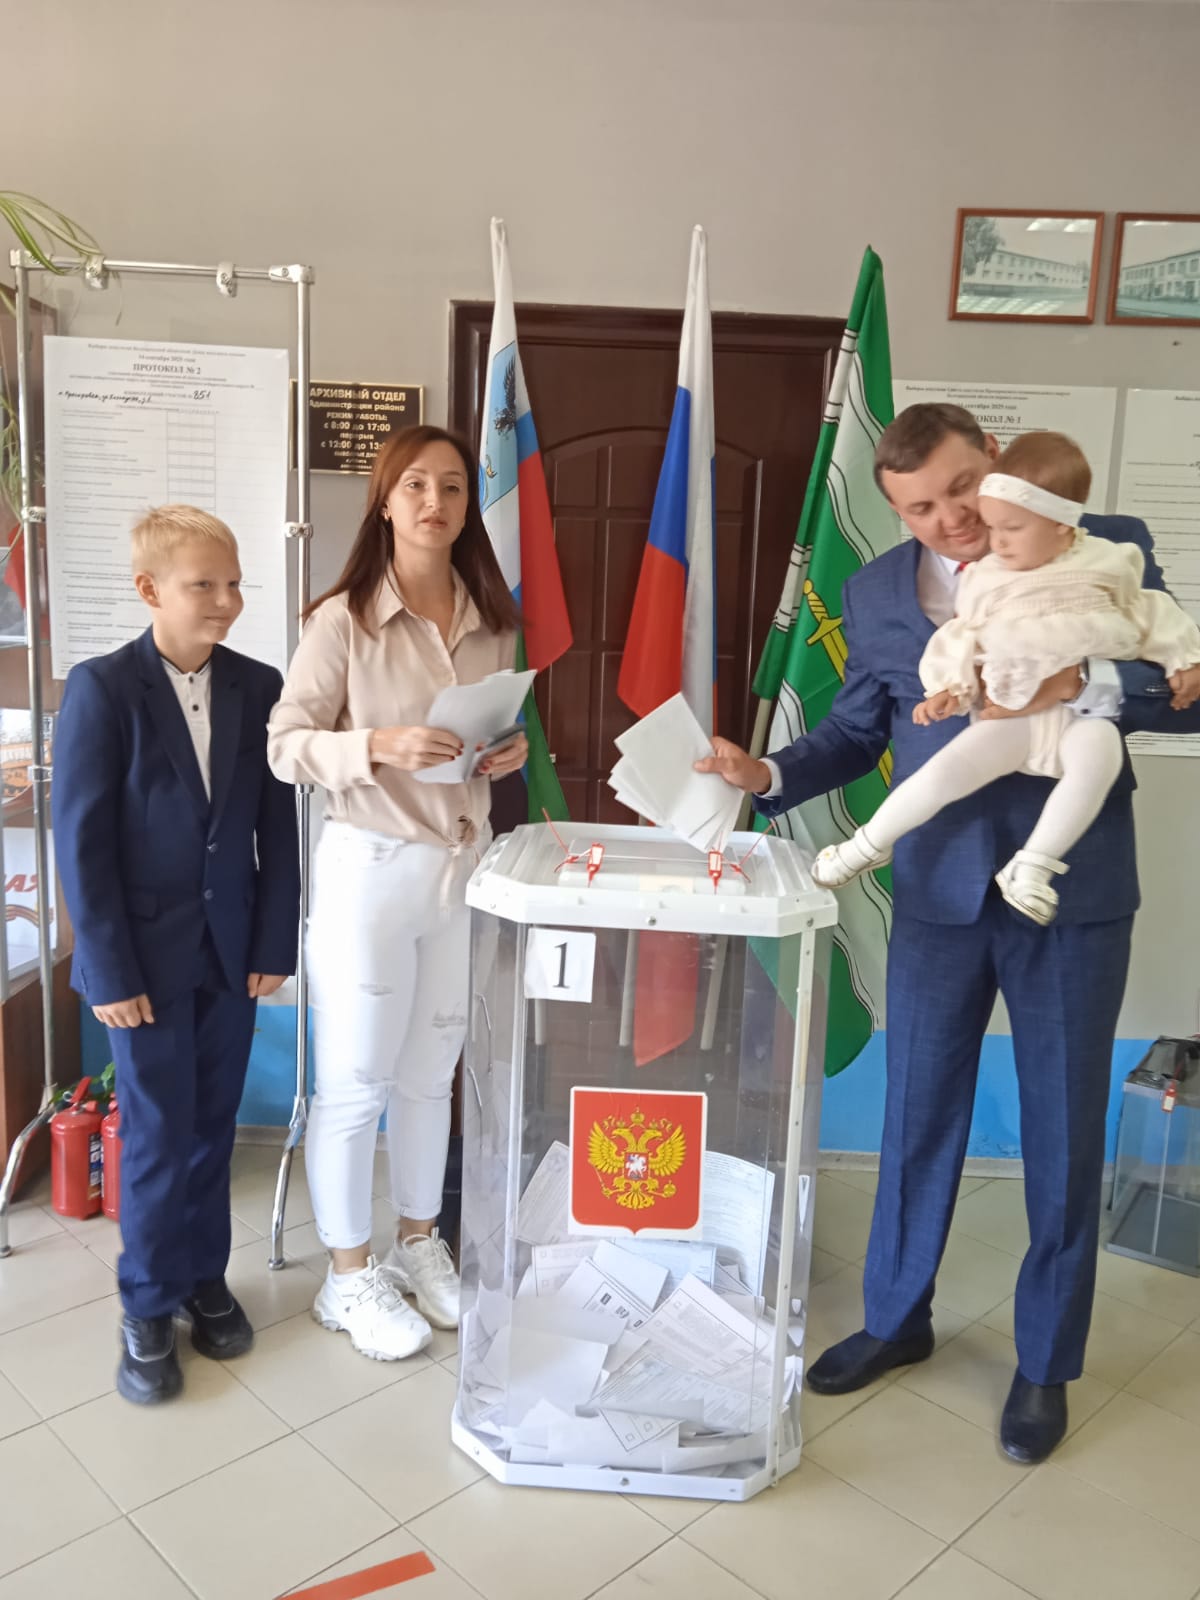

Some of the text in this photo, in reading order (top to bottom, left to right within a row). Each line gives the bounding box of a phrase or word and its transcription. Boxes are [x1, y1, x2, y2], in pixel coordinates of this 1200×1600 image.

[133, 363, 183, 373] ПРОТОКОЛ
[310, 387, 406, 402] АРХИВНЫЙ ОТДЕЛ
[374, 403, 405, 411] района
[1016, 416, 1022, 424] 1
[330, 421, 350, 430] 8:00
[367, 422, 391, 432] 17:00
[320, 440, 327, 448] с
[328, 439, 352, 449] 12:00
[552, 942, 570, 988] 1
